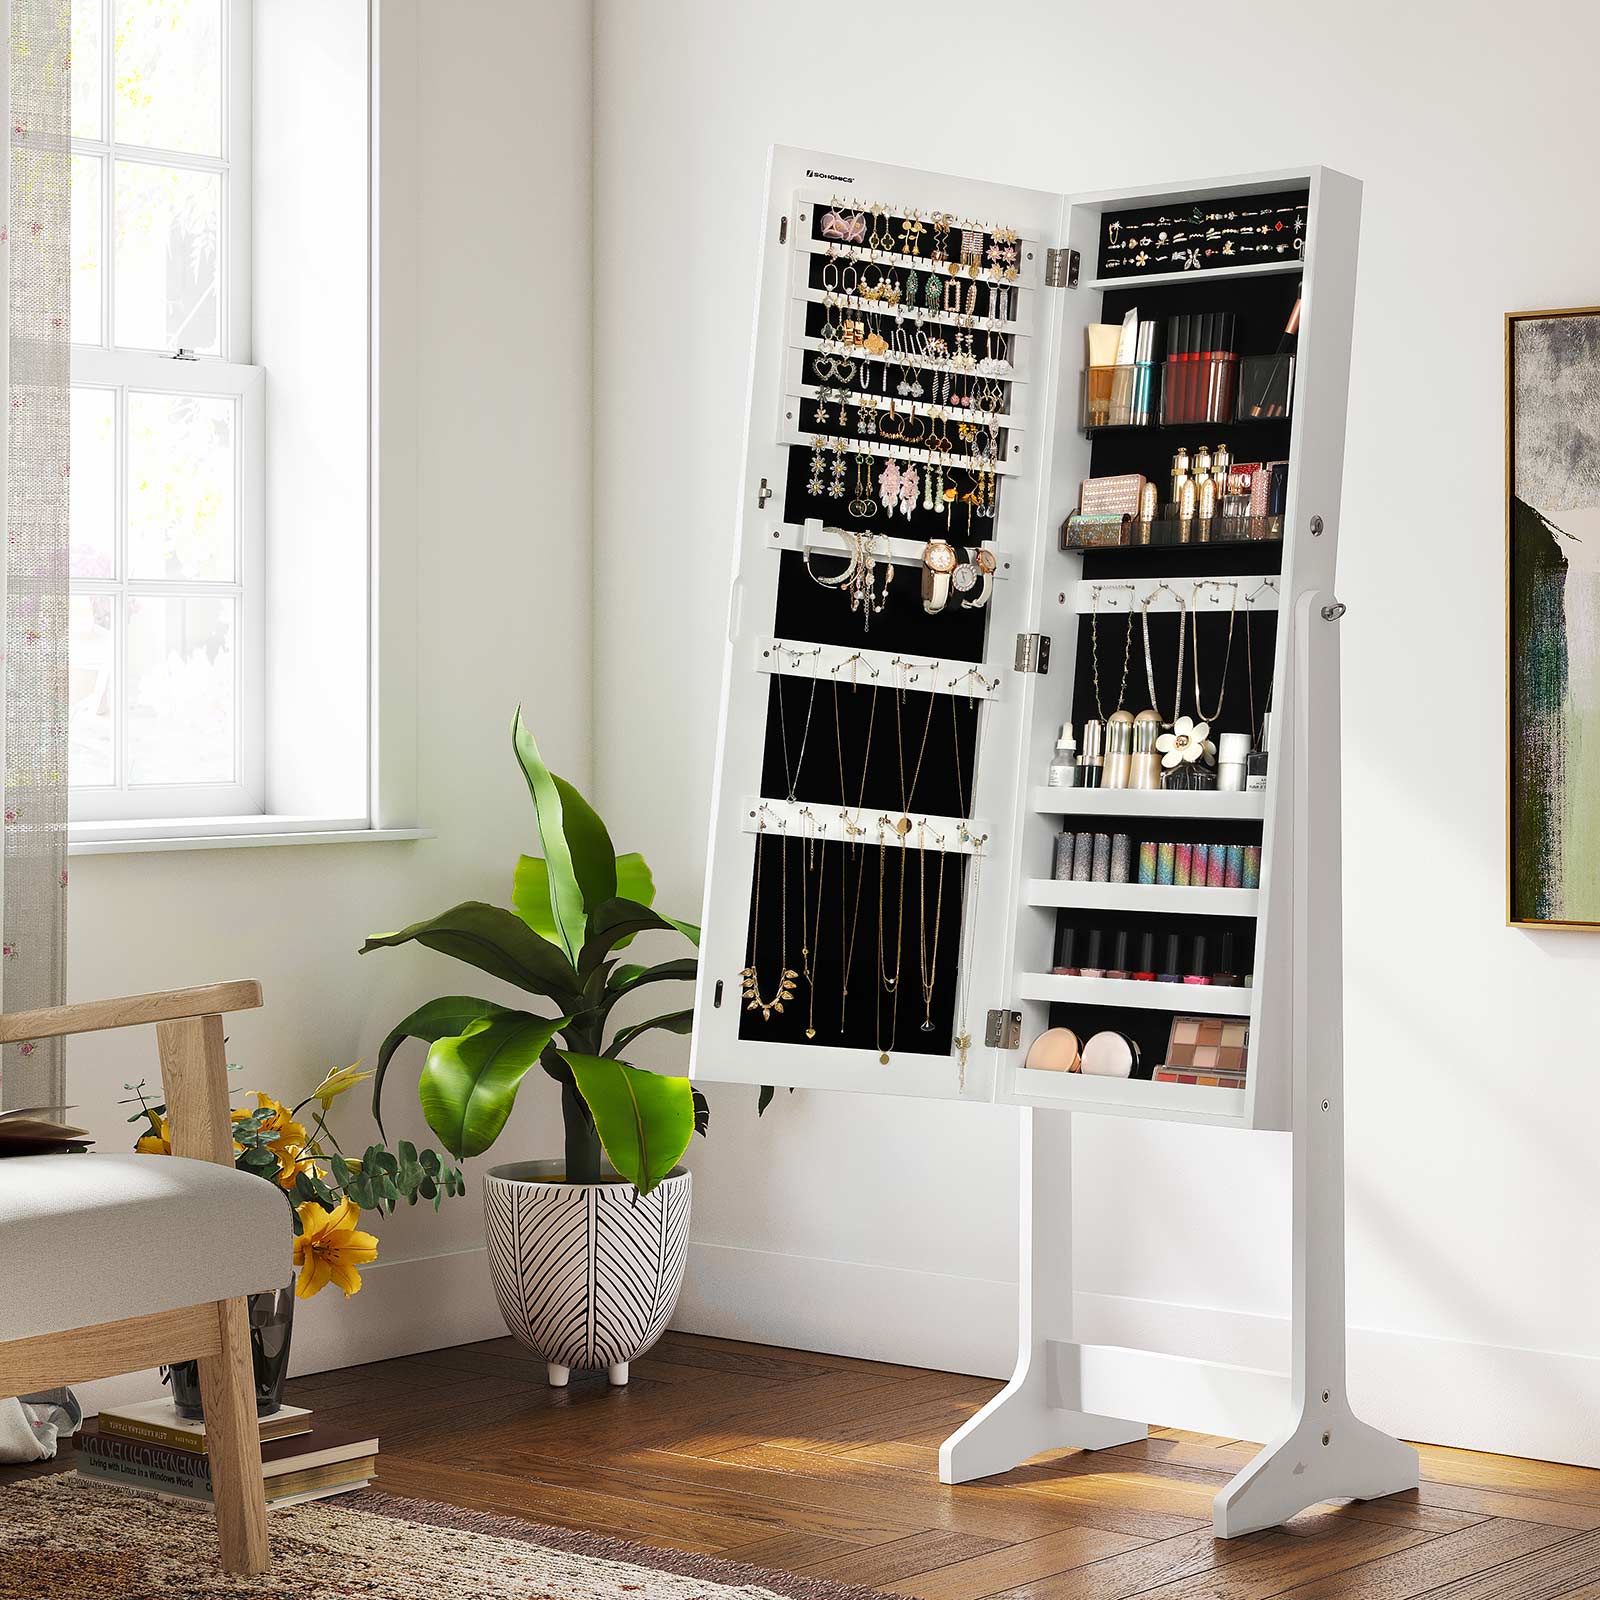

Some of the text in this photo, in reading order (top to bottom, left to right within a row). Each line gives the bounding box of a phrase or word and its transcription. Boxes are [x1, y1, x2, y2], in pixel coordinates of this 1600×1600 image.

[89, 1456, 107, 1471] Living
[108, 1462, 119, 1471] with
[120, 1464, 136, 1475] Linux
[137, 1467, 143, 1477] in
[149, 1471, 175, 1484] Windows
[175, 1475, 193, 1488] World
